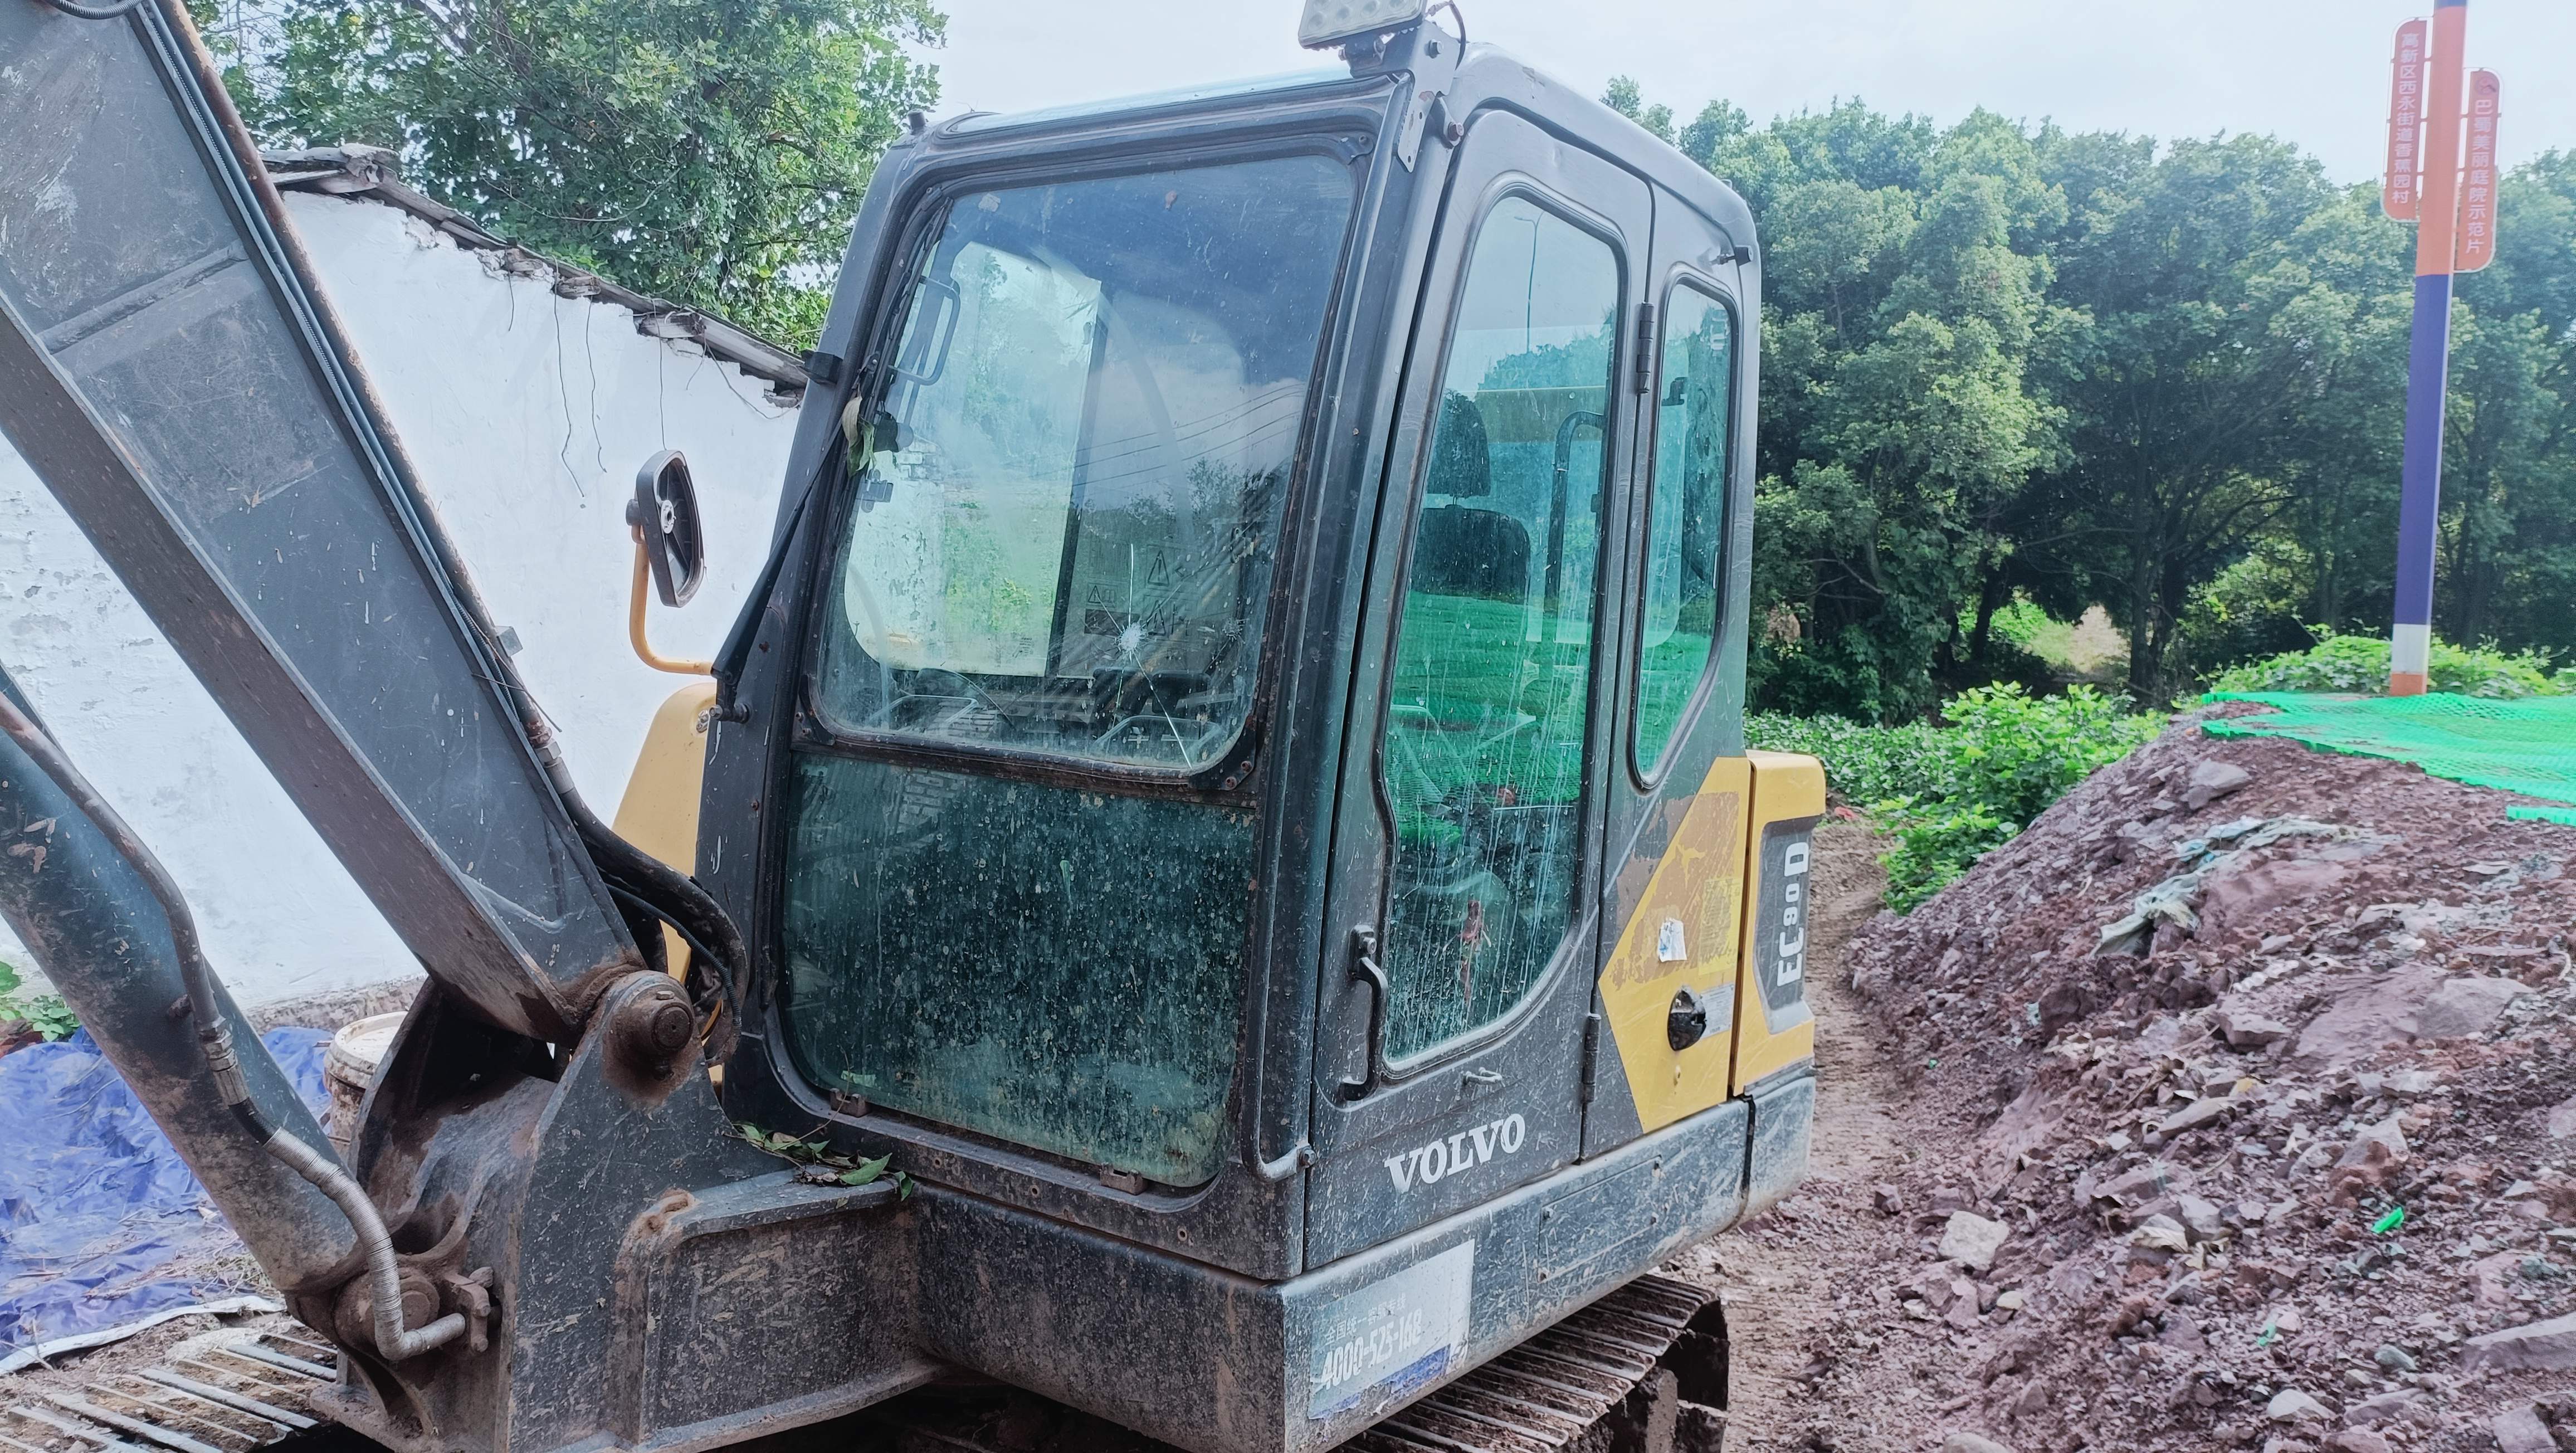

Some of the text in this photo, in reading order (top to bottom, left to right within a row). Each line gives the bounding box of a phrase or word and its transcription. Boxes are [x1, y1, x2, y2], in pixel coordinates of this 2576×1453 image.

[2392, 33, 2419, 204] 高新区西永街道香蕉园村
[2466, 99, 2493, 254] 巴蜀美丽庭院示范片
[1384, 1113, 1525, 1193] VOLVO
[1321, 1310, 1422, 1391] 4000-525-168
[1324, 1293, 1406, 1343] 全国统一客服专线
